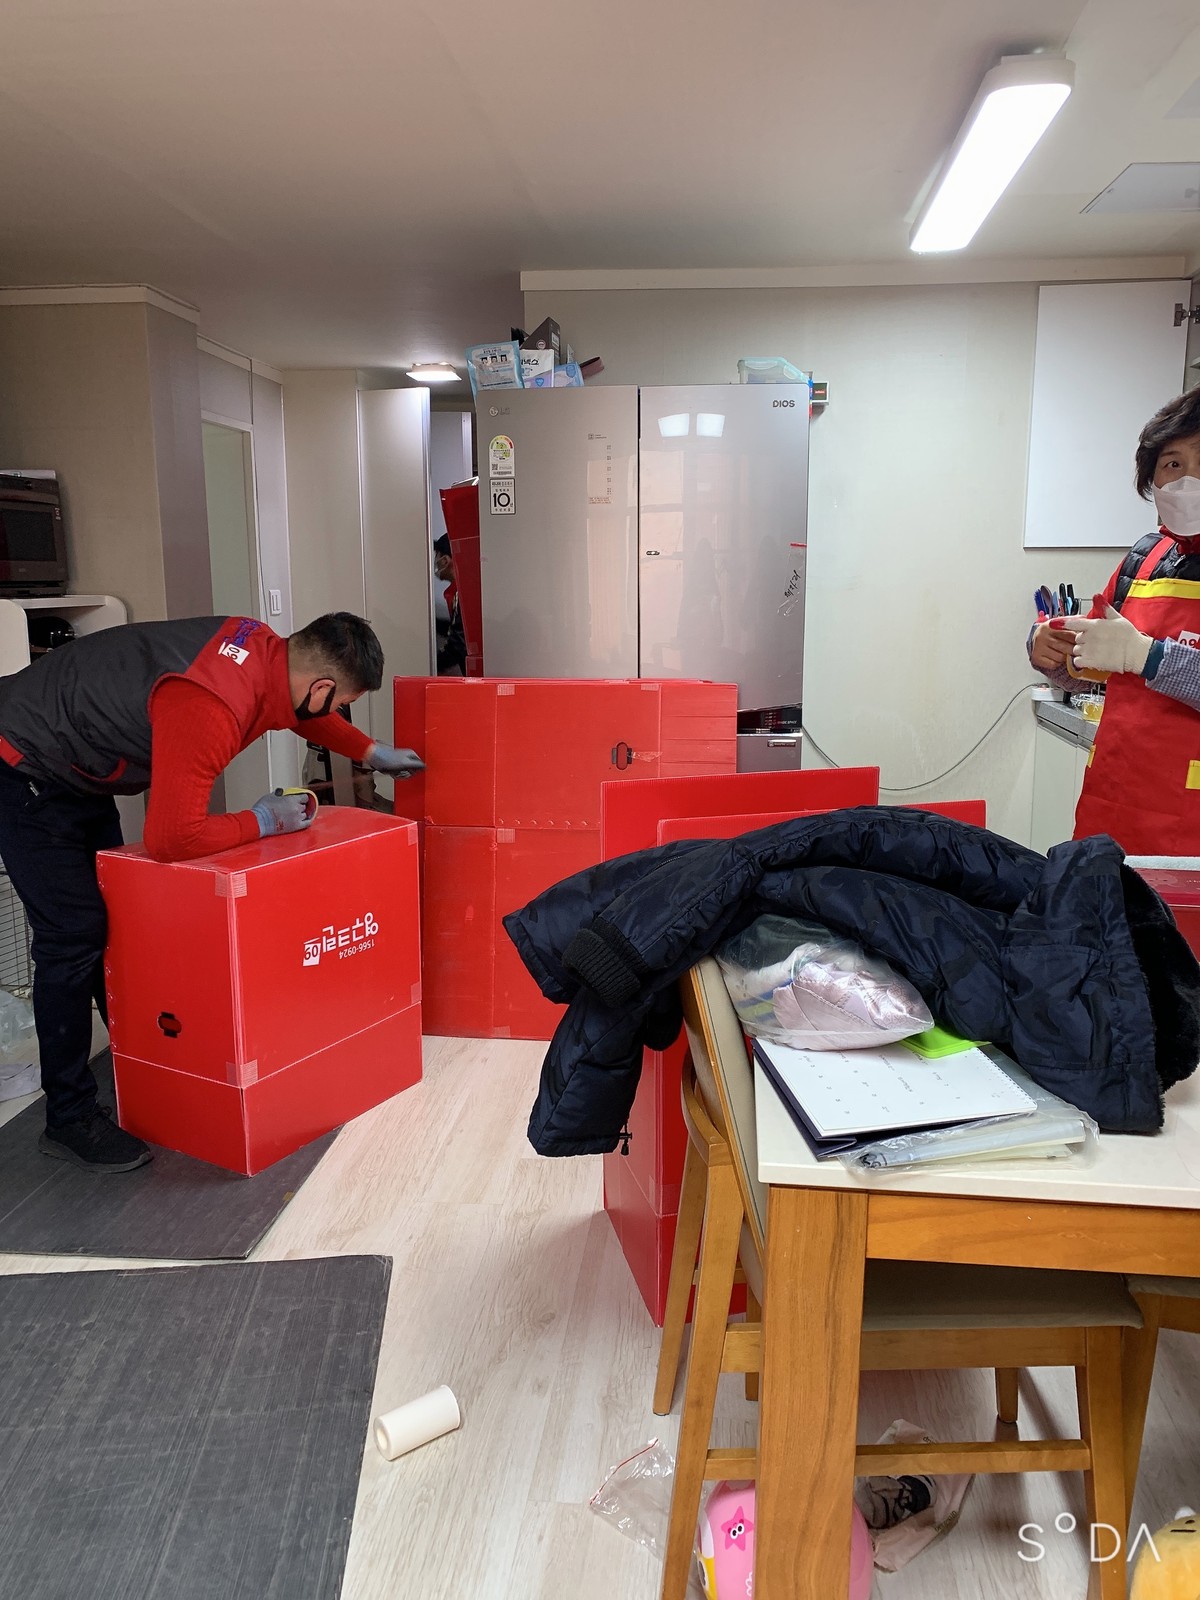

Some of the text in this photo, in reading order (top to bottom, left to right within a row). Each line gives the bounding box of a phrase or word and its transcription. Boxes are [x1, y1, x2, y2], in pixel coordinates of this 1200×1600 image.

[772, 399, 795, 408] DIOS
[322, 911, 379, 953] 영구크린
[338, 938, 375, 960] 1566-0924
